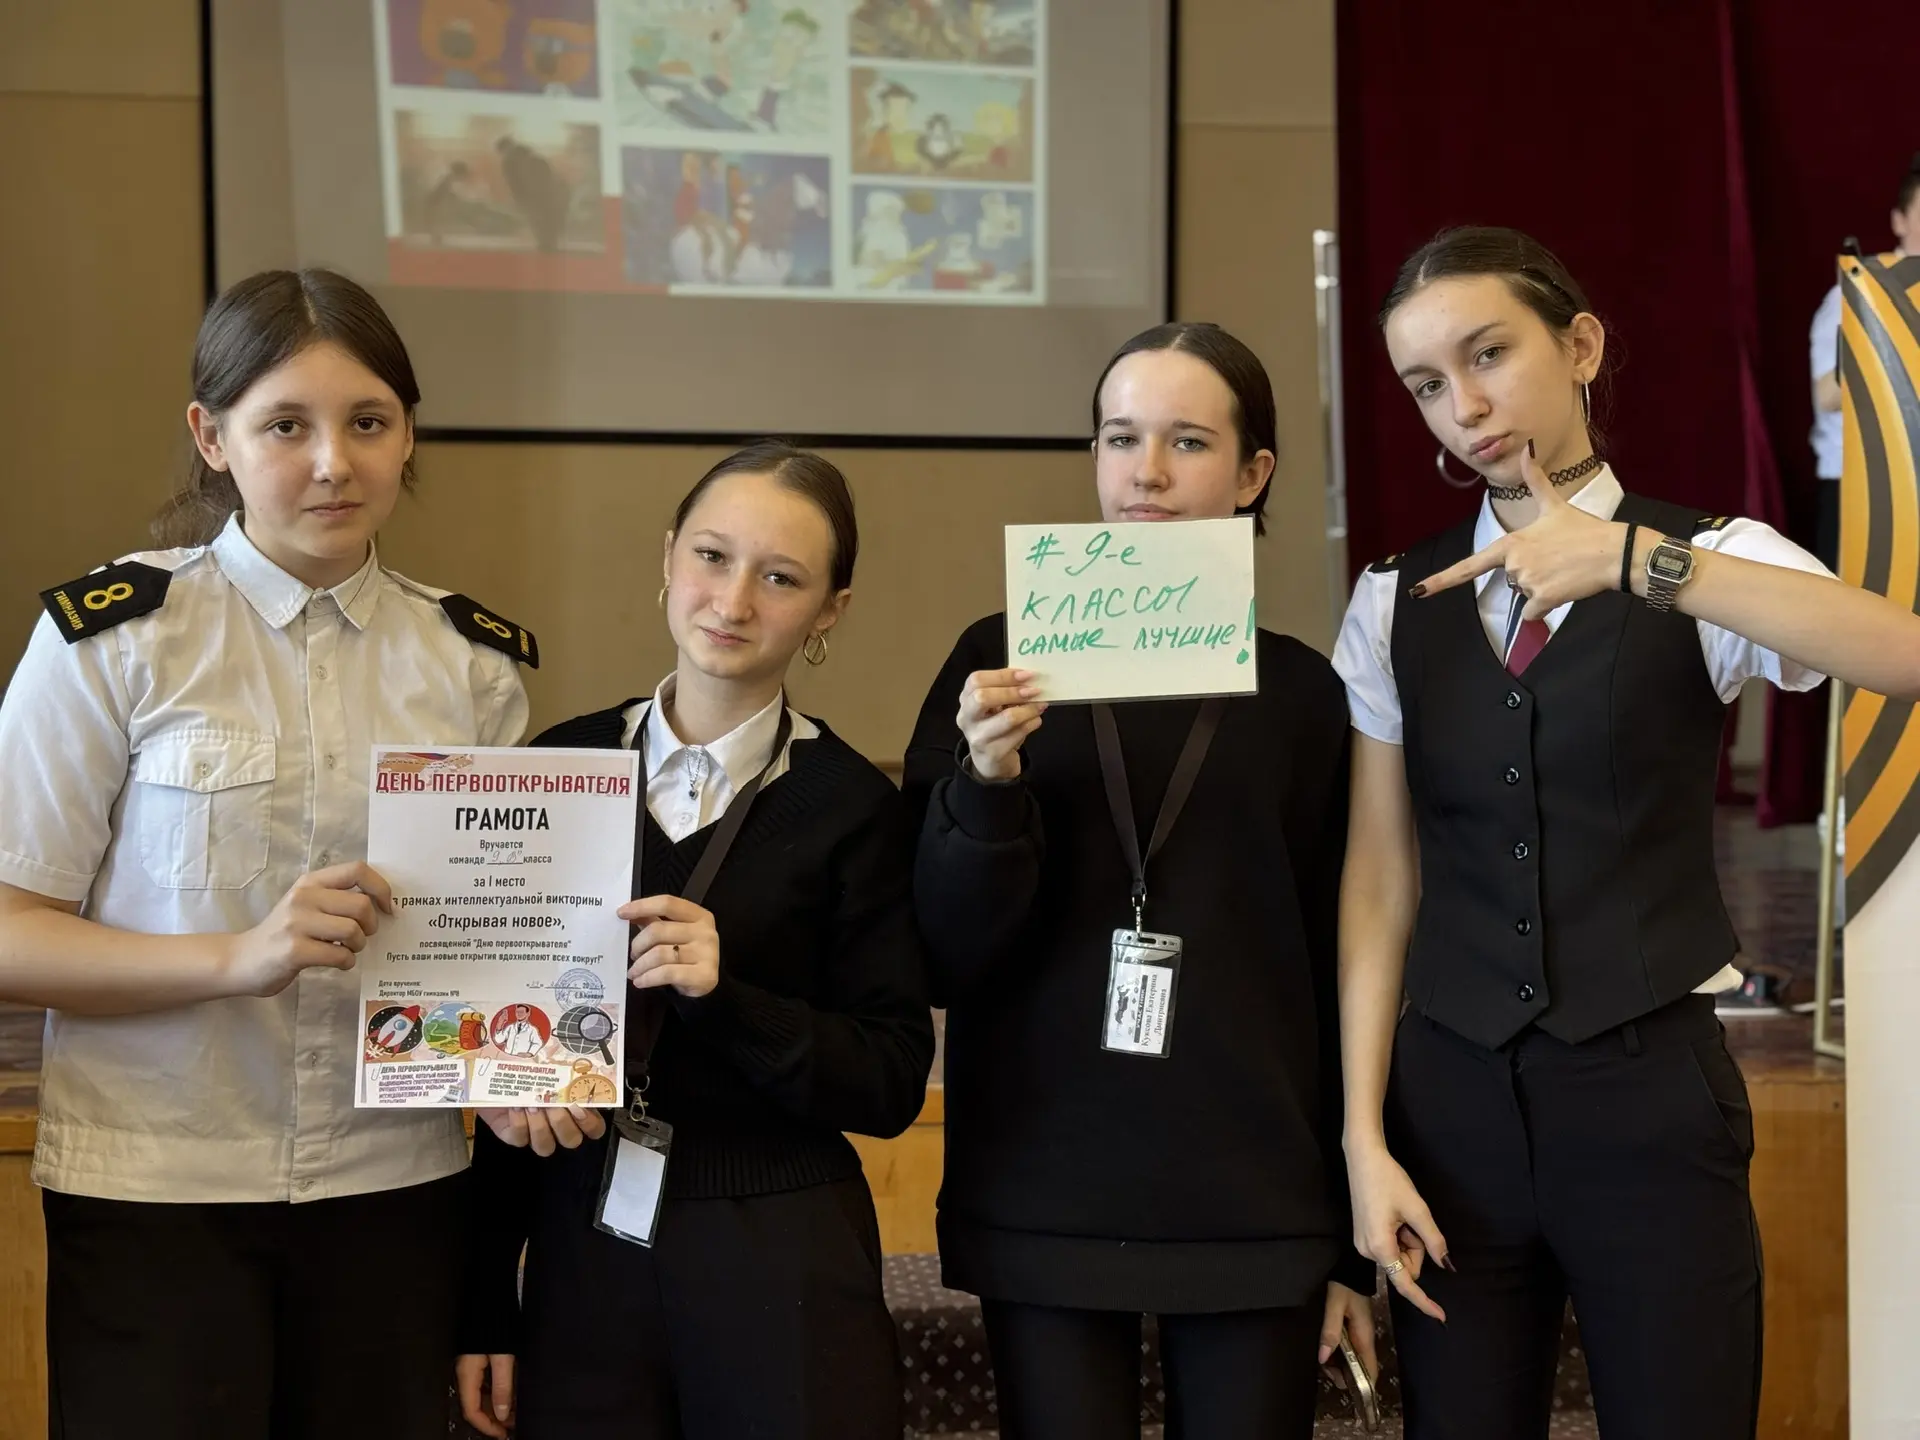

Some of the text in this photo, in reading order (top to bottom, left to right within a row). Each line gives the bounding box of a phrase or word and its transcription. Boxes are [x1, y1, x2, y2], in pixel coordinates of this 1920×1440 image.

[83, 582, 134, 610] 8
[53, 590, 85, 631] ГИМНАЗИЯ
[473, 612, 512, 638] 8
[376, 772, 631, 795] ДЕНЬ ПЕРВООТКРЫВАТЕЛЯ
[455, 808, 550, 831] ГРАМОТА
[480, 839, 523, 852] Вручается
[449, 856, 485, 865] команде
[523, 855, 552, 864] класса
[473, 878, 486, 887] за
[495, 877, 526, 887] место
[402, 897, 441, 909] рамках
[445, 892, 543, 908] интеллектуальной
[545, 895, 603, 907] викторины
[428, 913, 565, 931] «Открывая новое»,
[419, 938, 472, 948] посвященной
[495, 940, 572, 950] первооткрывателя"
[386, 952, 409, 962] Пусть
[411, 953, 432, 961] ваши
[433, 953, 458, 961] новые
[460, 953, 497, 962] открытия
[499, 953, 550, 962] вдохновляют
[552, 954, 570, 962] всех
[379, 989, 406, 997] Директор
